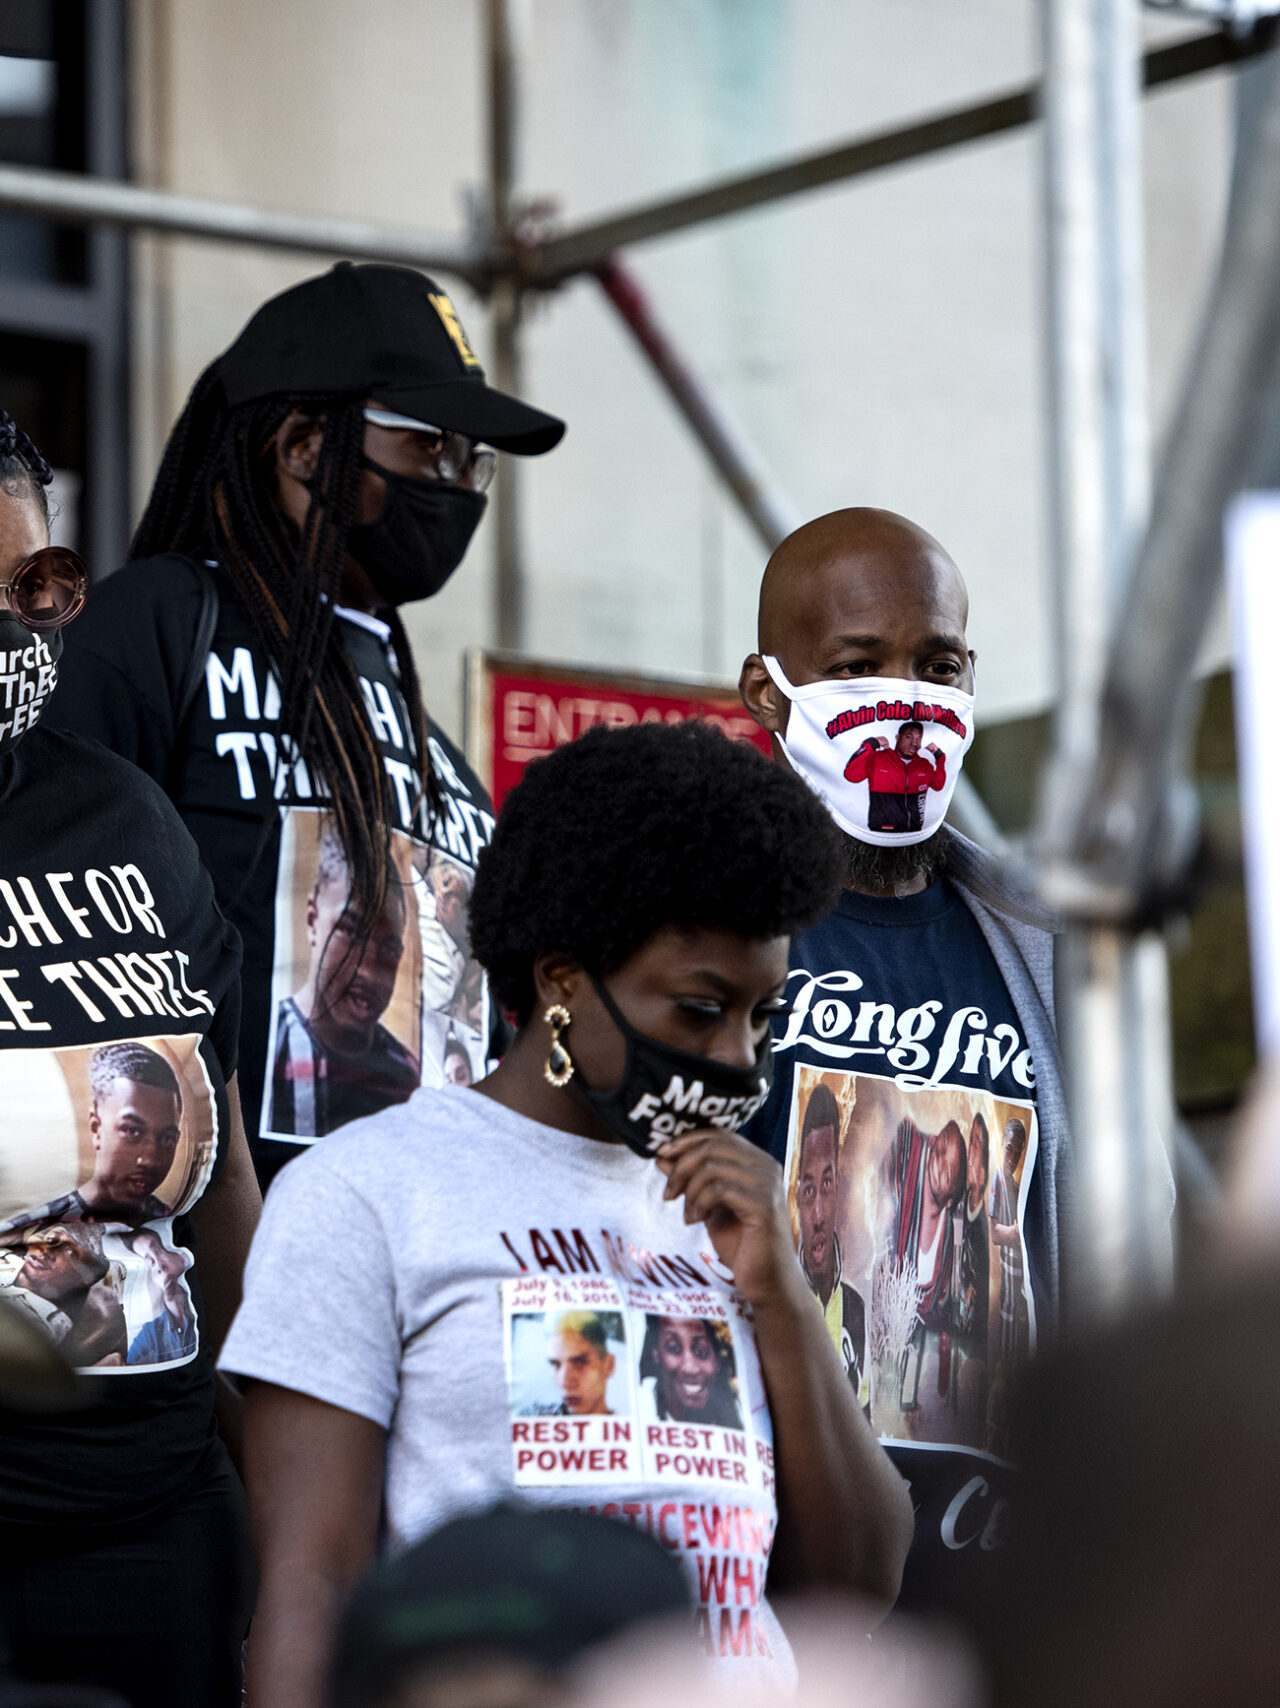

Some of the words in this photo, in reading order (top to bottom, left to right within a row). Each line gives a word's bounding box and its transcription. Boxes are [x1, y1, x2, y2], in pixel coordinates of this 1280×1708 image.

[825, 705, 876, 740] #Alvin
[876, 700, 913, 721] Cole
[44, 863, 167, 939] FOR
[40, 949, 217, 1024] THREE
[768, 968, 944, 1072] Long
[627, 1092, 697, 1136] For
[499, 1231, 528, 1272] I
[528, 1228, 602, 1275] AM
[512, 1294, 546, 1308] July
[513, 1278, 547, 1293] July
[511, 1423, 590, 1443] REST
[602, 1421, 632, 1442] IN
[646, 1425, 714, 1451] REST
[722, 1433, 747, 1457] IN
[517, 1449, 629, 1472] POWER
[656, 1453, 748, 1485] POWER
